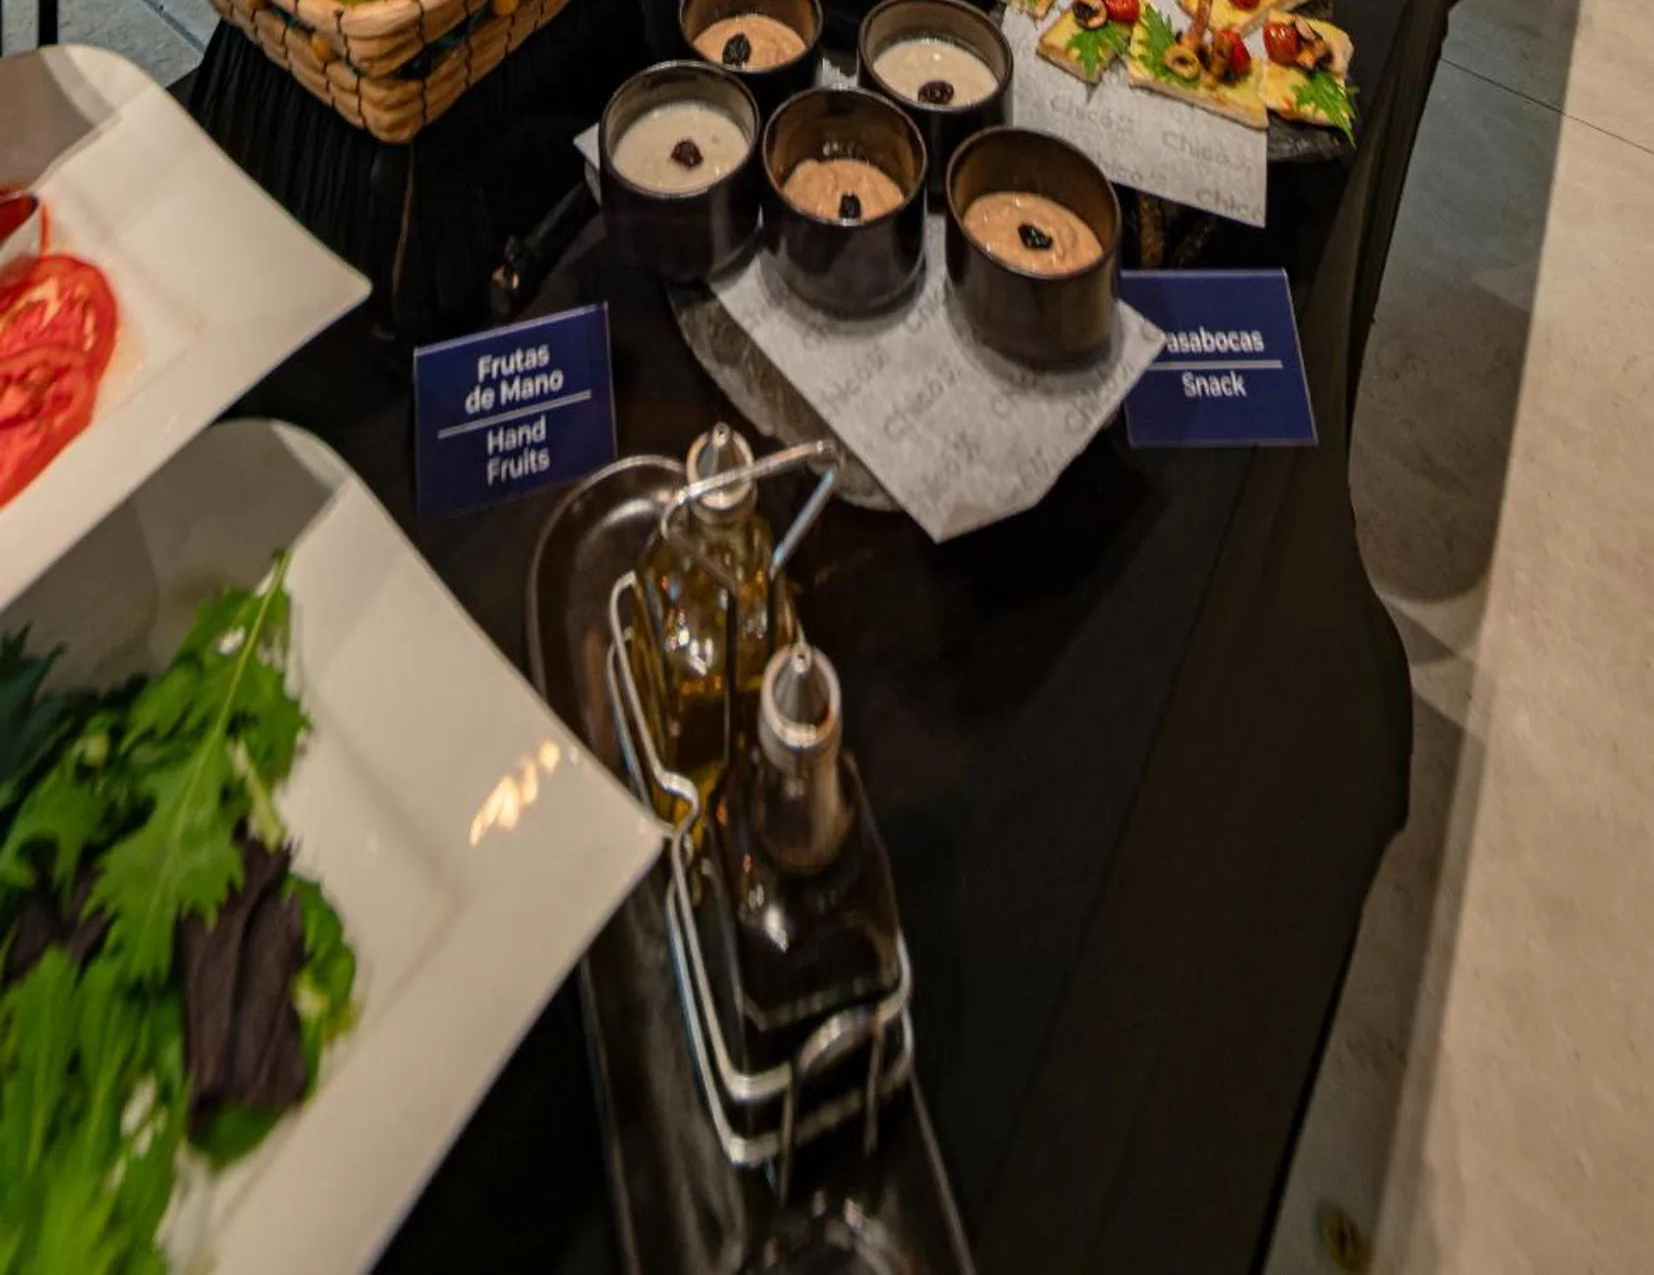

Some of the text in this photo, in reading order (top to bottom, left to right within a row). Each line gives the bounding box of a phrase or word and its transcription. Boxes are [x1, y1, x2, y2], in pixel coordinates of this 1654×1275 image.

[1166, 326, 1265, 353] asabocas
[477, 343, 550, 383] Frutas
[464, 369, 564, 414] de Mano
[1181, 370, 1247, 398] Snack
[487, 414, 547, 455] Hand
[487, 447, 550, 486] Fruits
